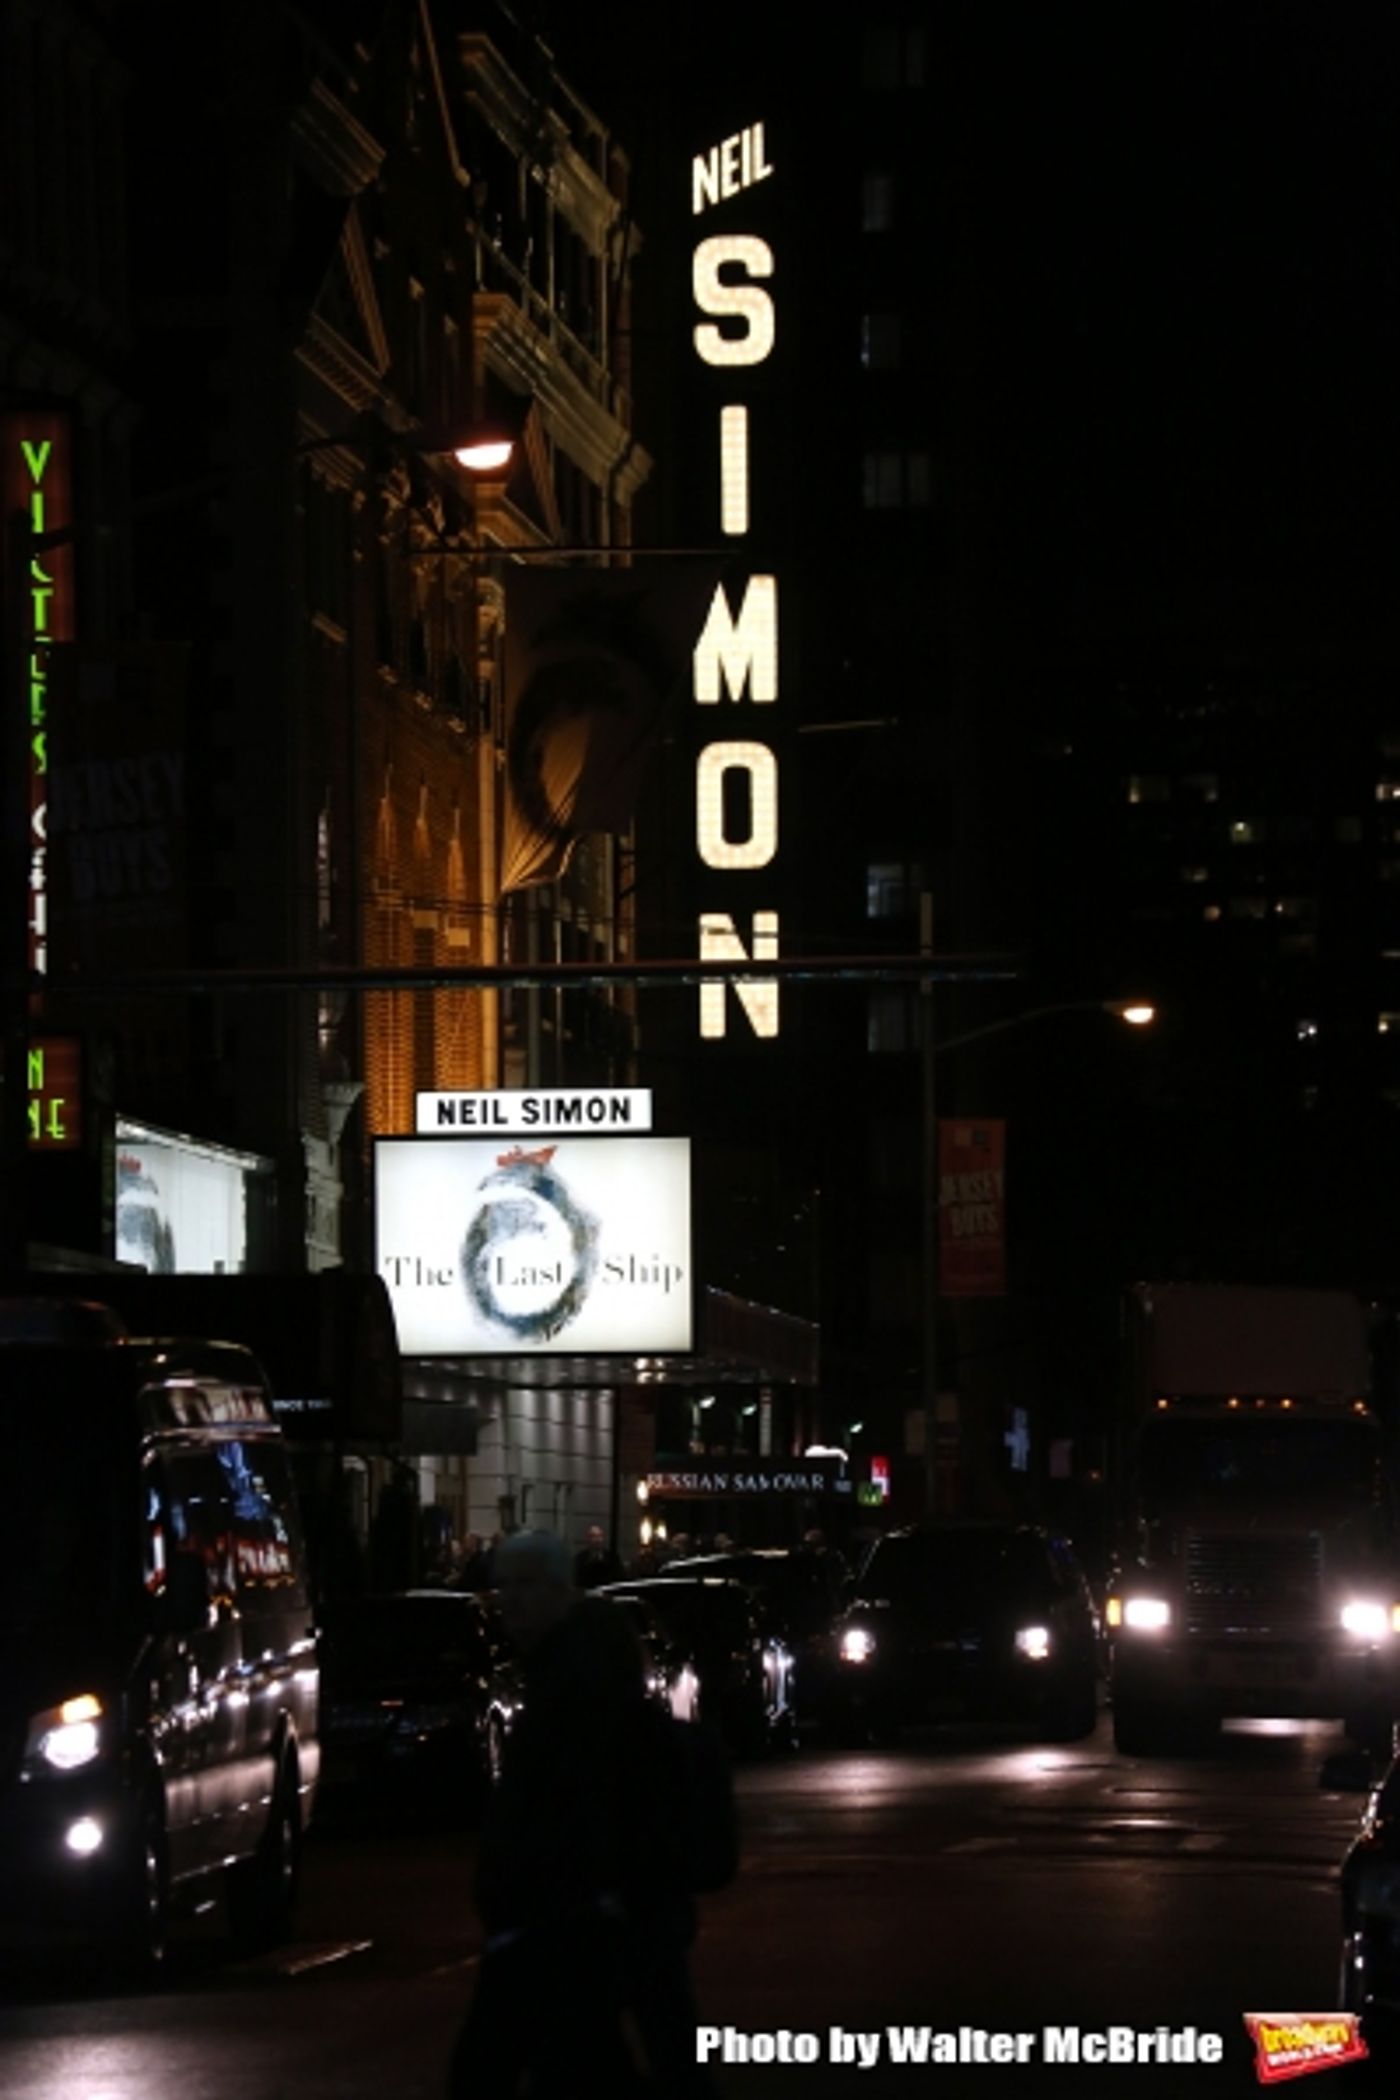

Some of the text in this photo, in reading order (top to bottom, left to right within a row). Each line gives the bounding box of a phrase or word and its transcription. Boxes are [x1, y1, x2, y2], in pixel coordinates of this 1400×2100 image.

[692, 122, 774, 215] NEIL
[692, 234, 778, 1038] SIMON
[436, 1096, 632, 1126] NEIL SIMON
[384, 1254, 685, 1294] The Last Ship
